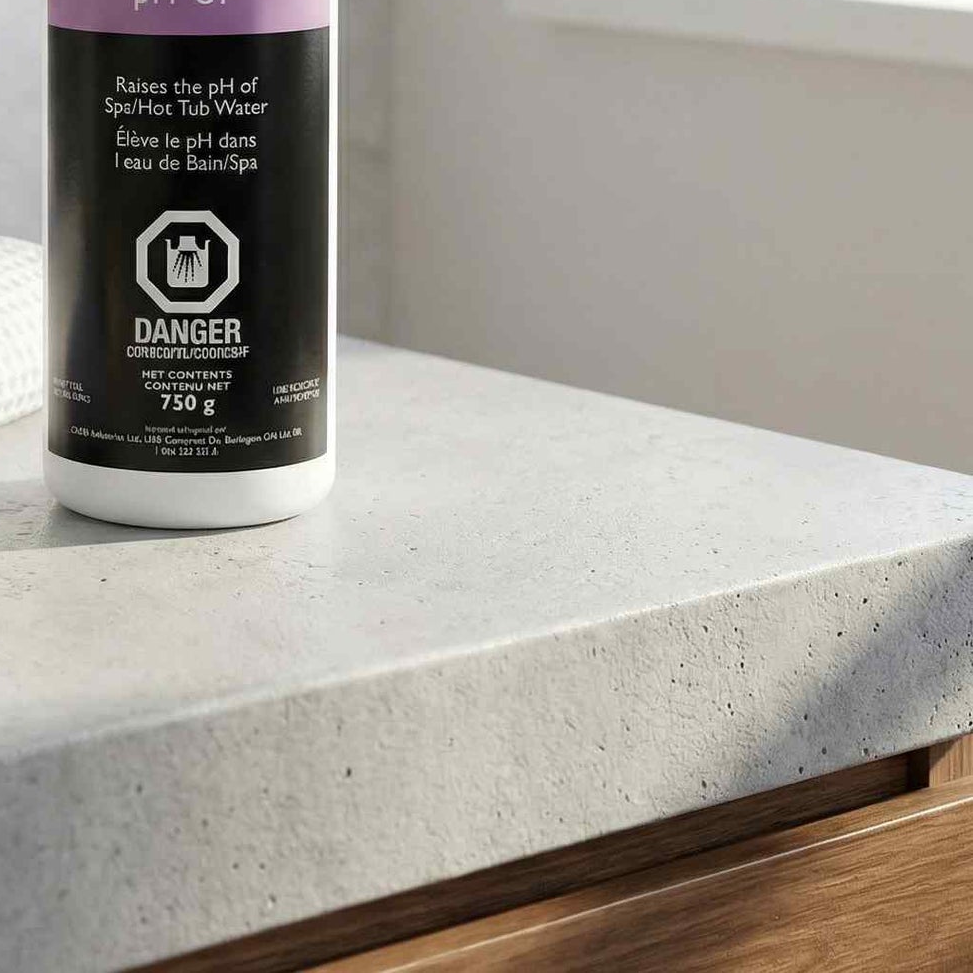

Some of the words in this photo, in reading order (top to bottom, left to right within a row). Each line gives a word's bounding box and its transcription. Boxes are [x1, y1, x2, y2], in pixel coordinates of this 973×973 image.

[116, 76, 168, 95] Raises
[173, 78, 203, 95] the
[208, 78, 234, 100] pH
[240, 76, 259, 94] of
[104, 97, 173, 119] Spa/Hot
[177, 99, 211, 116] Tub
[214, 99, 269, 115] Water
[116, 125, 159, 148] Élève
[165, 132, 181, 149] le
[186, 132, 212, 154] pH
[218, 132, 257, 149] dans
[123, 157, 153, 172] eau
[159, 154, 181, 171] de
[186, 153, 259, 175] Bain/Spa
[134, 317, 242, 345] DANGER
[144, 381, 204, 392] CONTENU
[206, 381, 232, 391] NET
[167, 370, 233, 380] CONTENTS
[160, 393, 197, 412] 750
[202, 398, 216, 417] g
